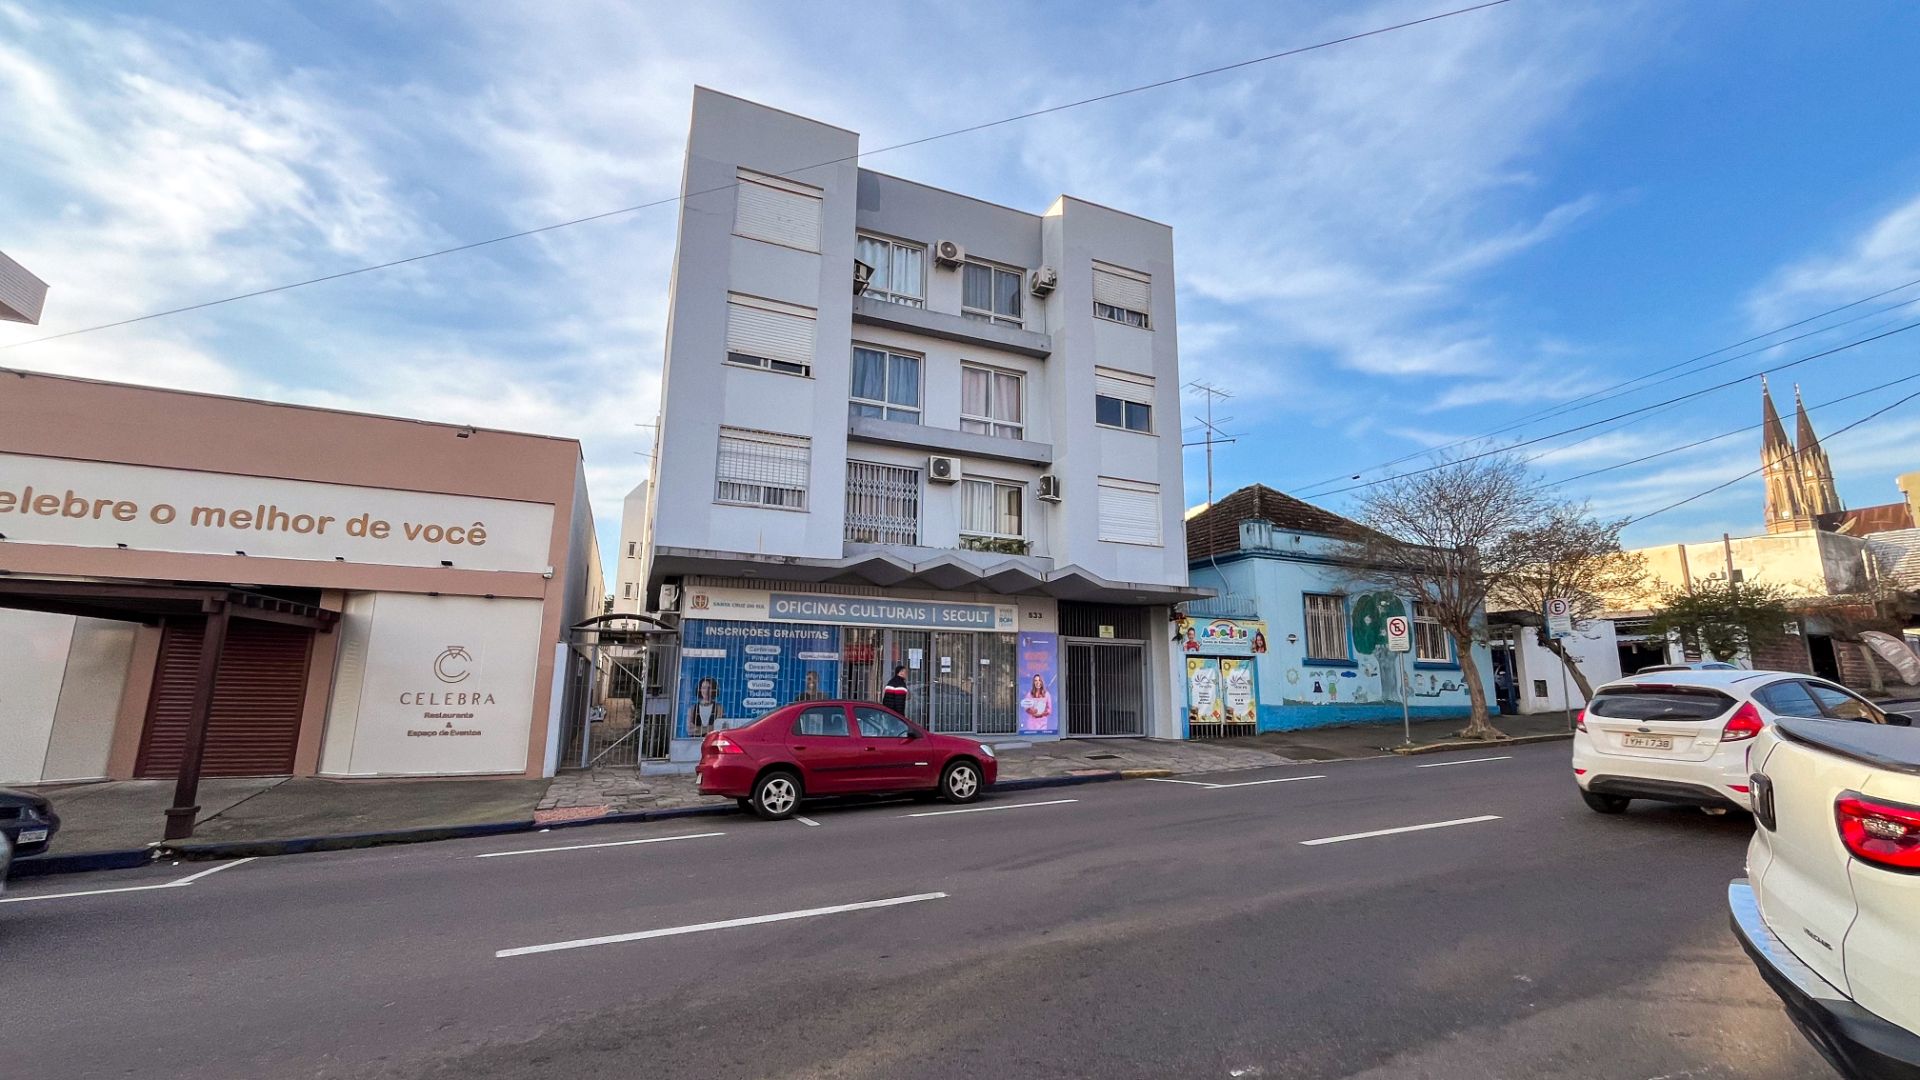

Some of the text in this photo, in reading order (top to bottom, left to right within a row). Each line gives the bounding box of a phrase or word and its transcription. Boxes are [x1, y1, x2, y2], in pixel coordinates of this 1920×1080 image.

[150, 504, 176, 524] o
[190, 504, 335, 535] melhor
[346, 513, 391, 539] de
[404, 522, 487, 546] você
[776, 600, 846, 616] OFICINAS
[850, 604, 926, 620] CULTURAIS
[942, 610, 989, 623] SECULT
[1554, 603, 1561, 612] E
[705, 626, 829, 640] INSCRIÇÕES GRATUITAS
[400, 692, 495, 705] CELEBRA
